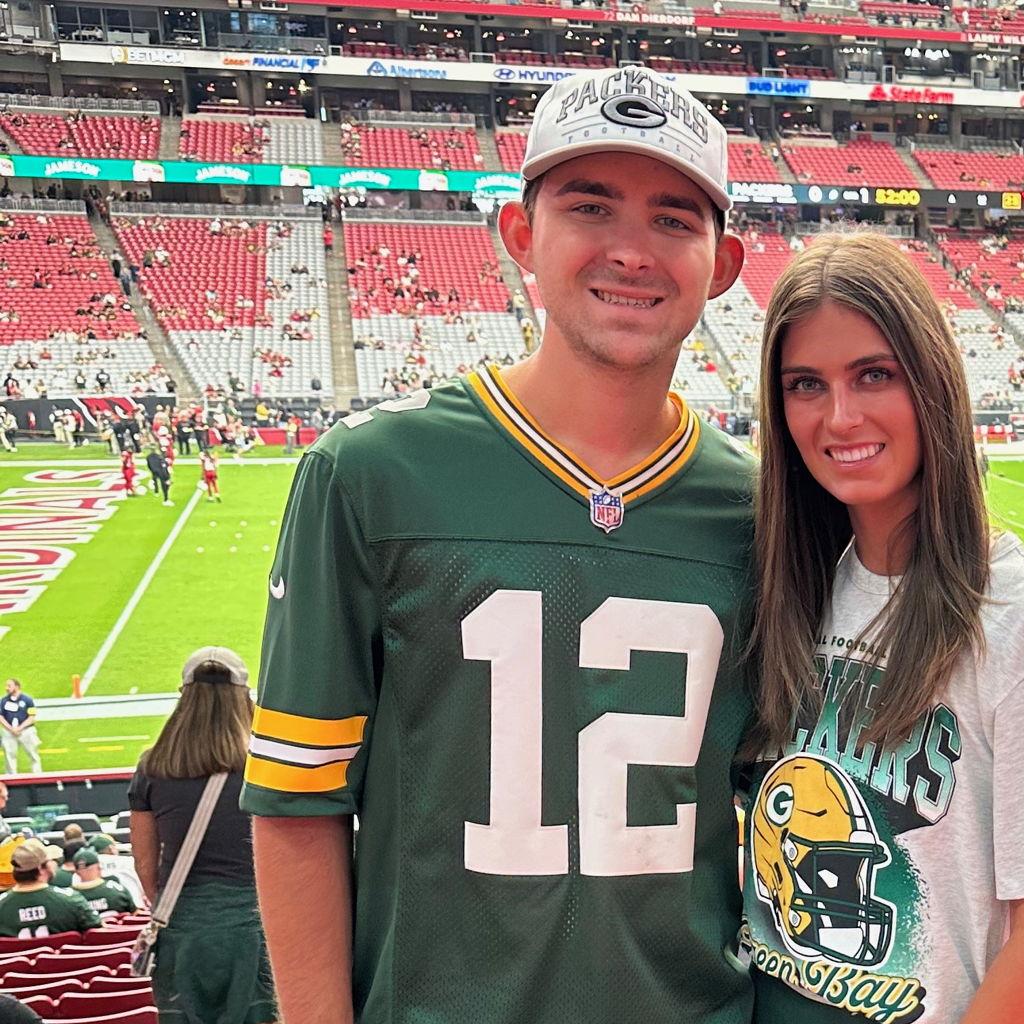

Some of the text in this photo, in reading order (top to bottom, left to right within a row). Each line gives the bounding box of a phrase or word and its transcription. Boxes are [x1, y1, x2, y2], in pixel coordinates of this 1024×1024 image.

[616, 12, 640, 22] DAN
[642, 14, 696, 25] DIERDORF
[252, 57, 300, 70] FINANCIAL
[390, 64, 447, 80] Albertsons
[518, 70, 577, 82] HYUNDA
[774, 82, 809, 94] LIGHT
[889, 86, 954, 103] State Farm
[556, 70, 709, 144] PACKERS
[600, 93, 668, 128] G
[568, 126, 696, 162] FOOTBALL
[596, 504, 620, 525] NFL
[460, 589, 724, 877] 12
[765, 783, 795, 825] G
